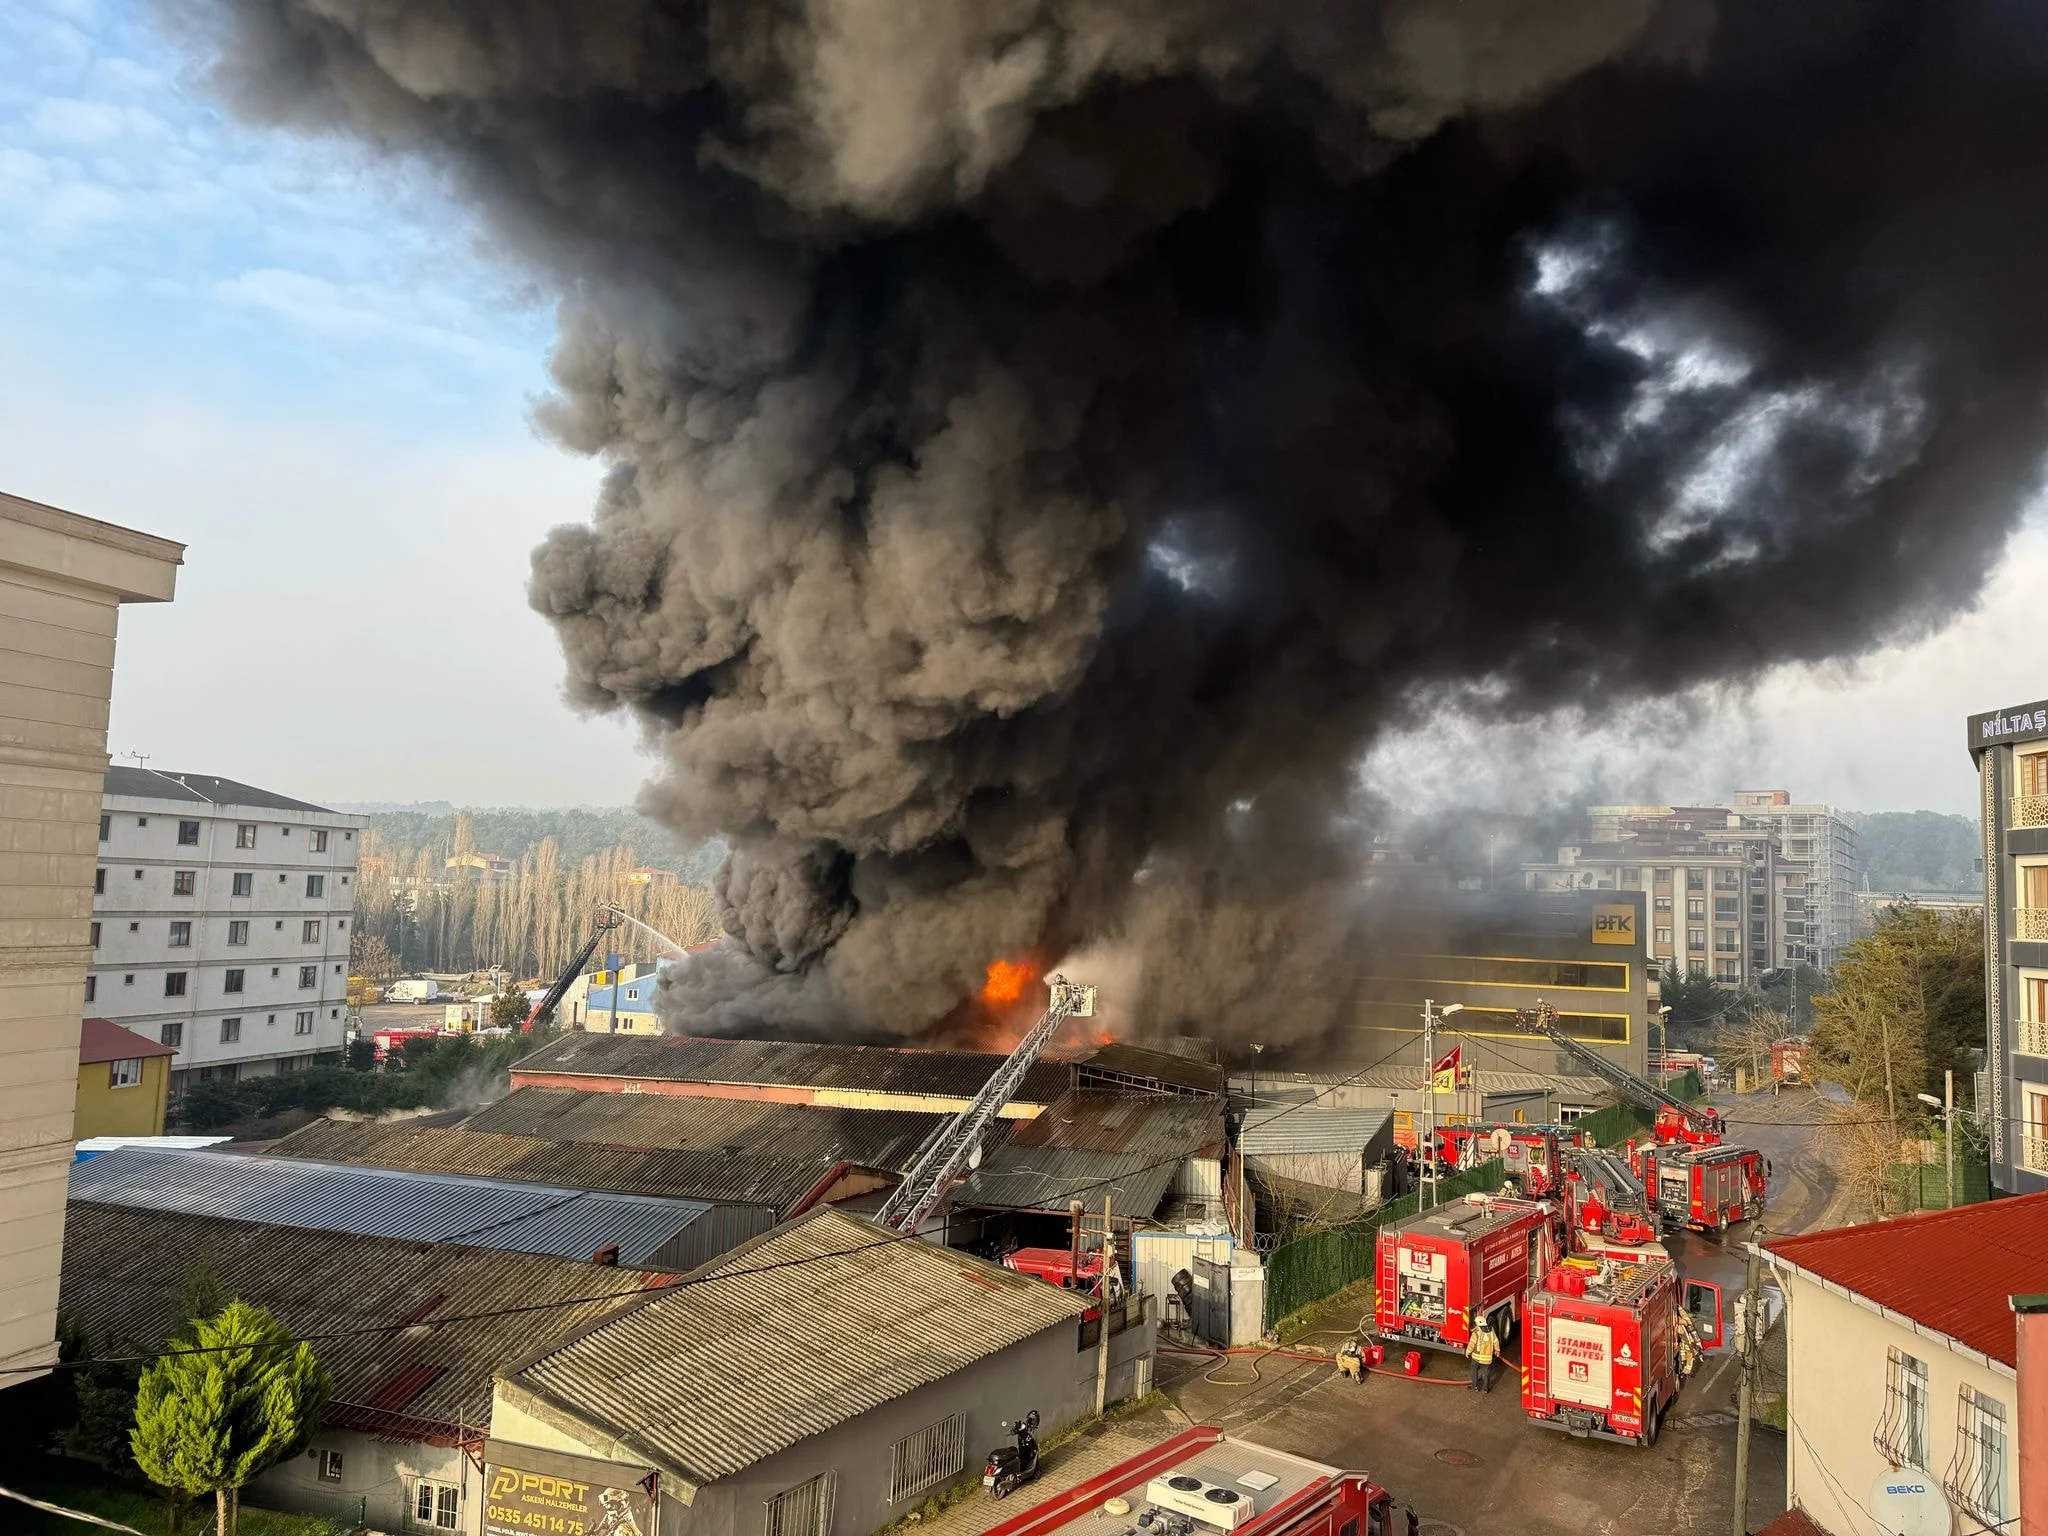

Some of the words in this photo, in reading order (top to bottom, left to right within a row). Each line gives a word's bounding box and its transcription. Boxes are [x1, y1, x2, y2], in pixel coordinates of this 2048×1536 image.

[1982, 710, 2046, 738] NİLTAŞ
[1595, 914, 1633, 932] BFK
[1413, 1251, 1429, 1265] 112
[1571, 1364, 1587, 1375] 112
[1886, 1485, 1926, 1494] BEKO
[521, 1494, 545, 1505] ASKERİ
[545, 1499, 588, 1513] MALZEMELER
[488, 1505, 521, 1524] 0535
[523, 1512, 547, 1529] 451
[549, 1517, 565, 1533] 14
[567, 1521, 584, 1536] 75
